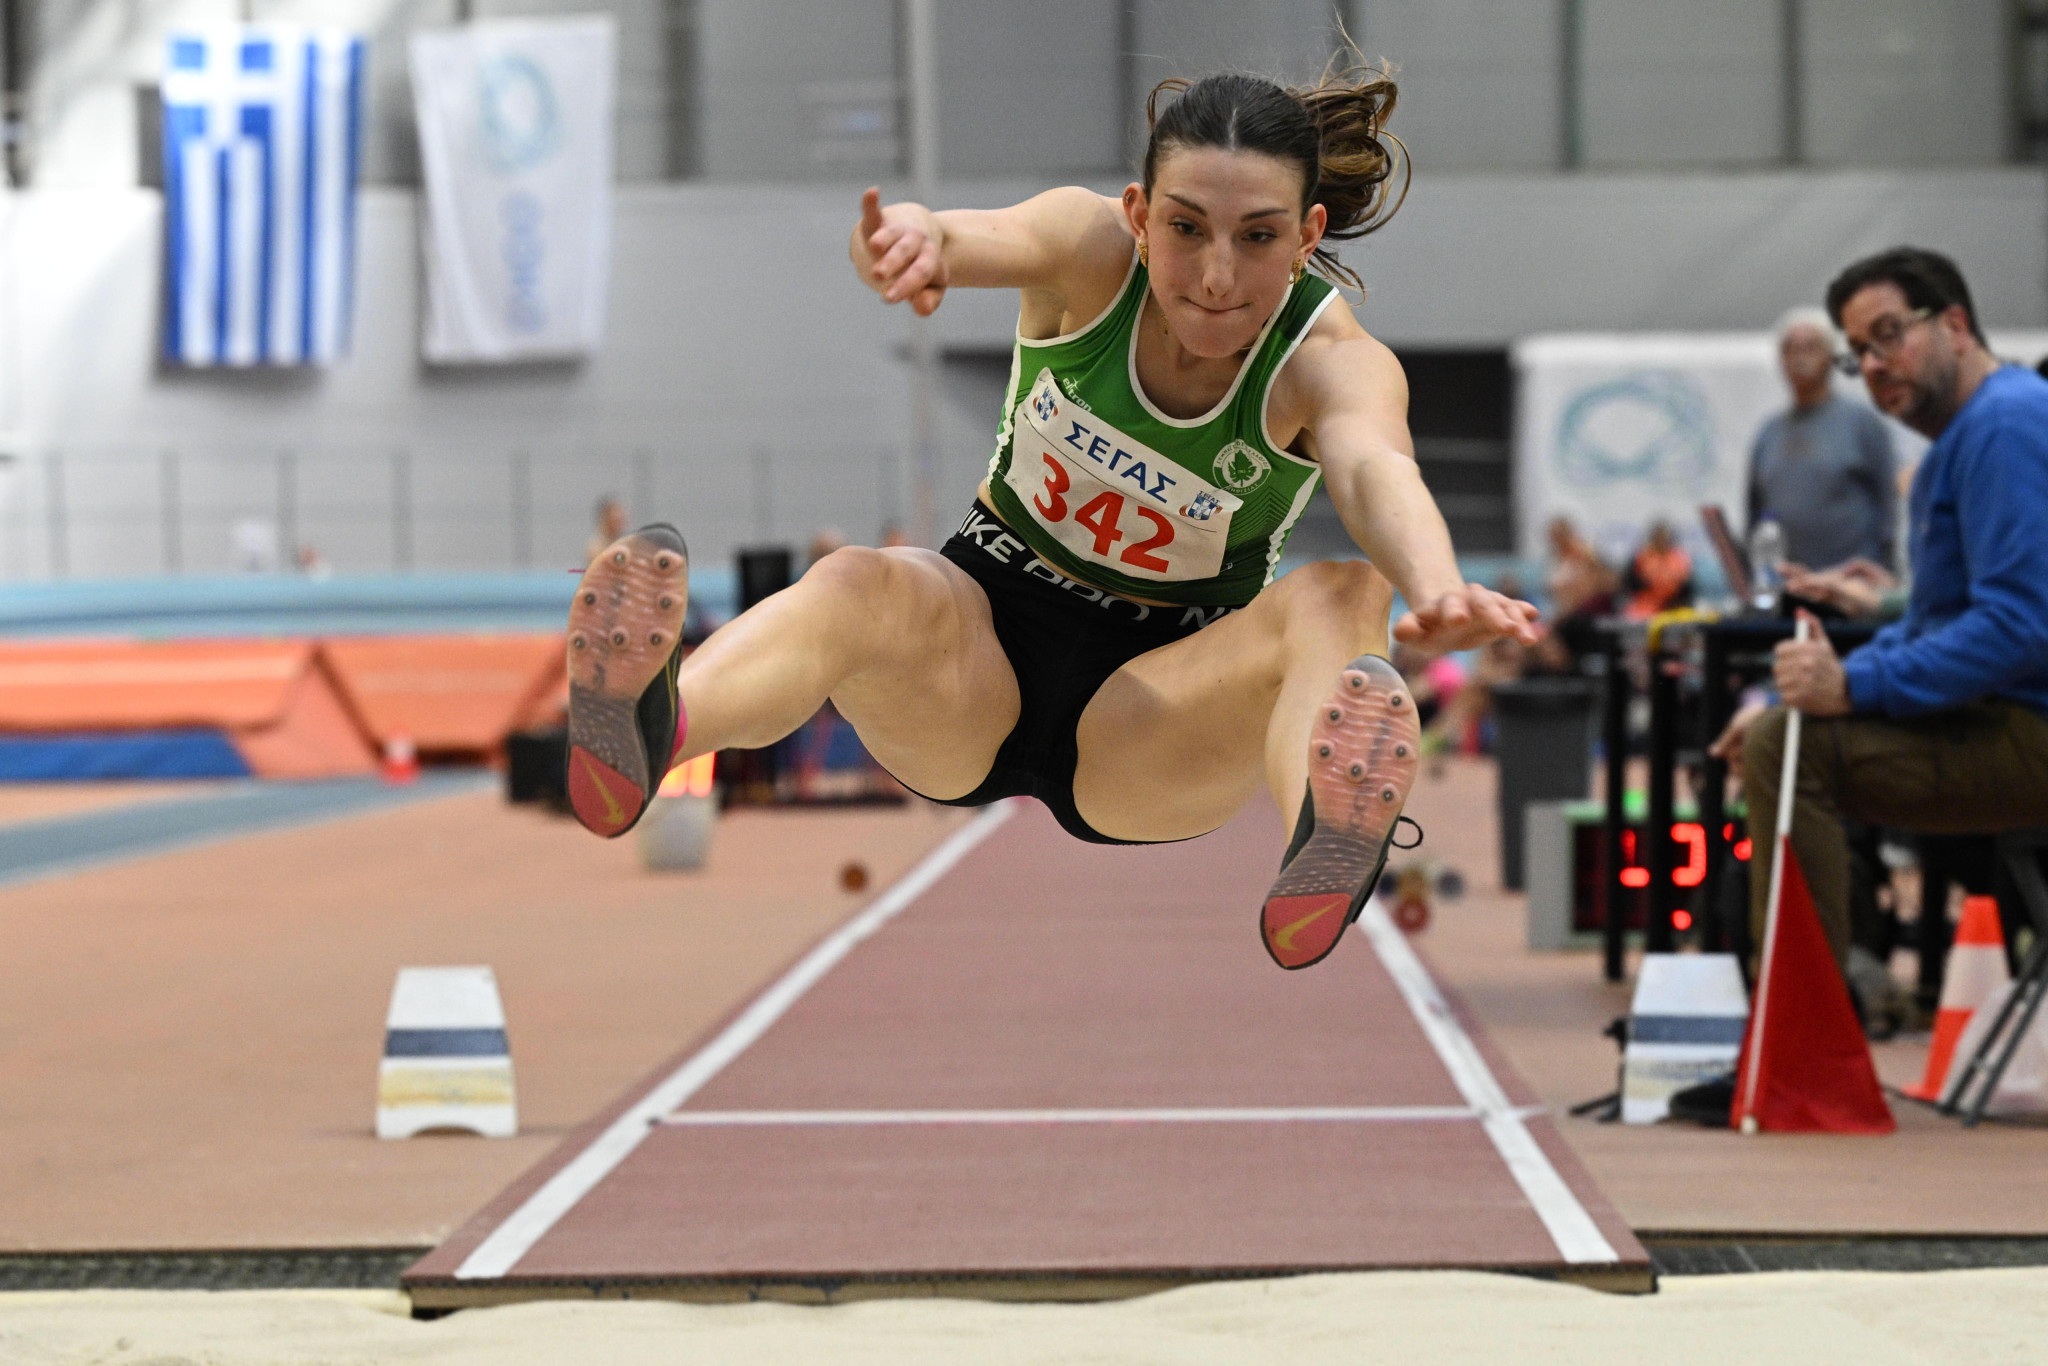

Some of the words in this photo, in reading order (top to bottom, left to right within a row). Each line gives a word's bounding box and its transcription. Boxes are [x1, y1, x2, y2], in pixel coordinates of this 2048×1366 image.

[1062, 377, 1093, 413] eltron
[1064, 420, 1176, 504] ΣΕΓΑΣ
[1033, 451, 1175, 574] 342
